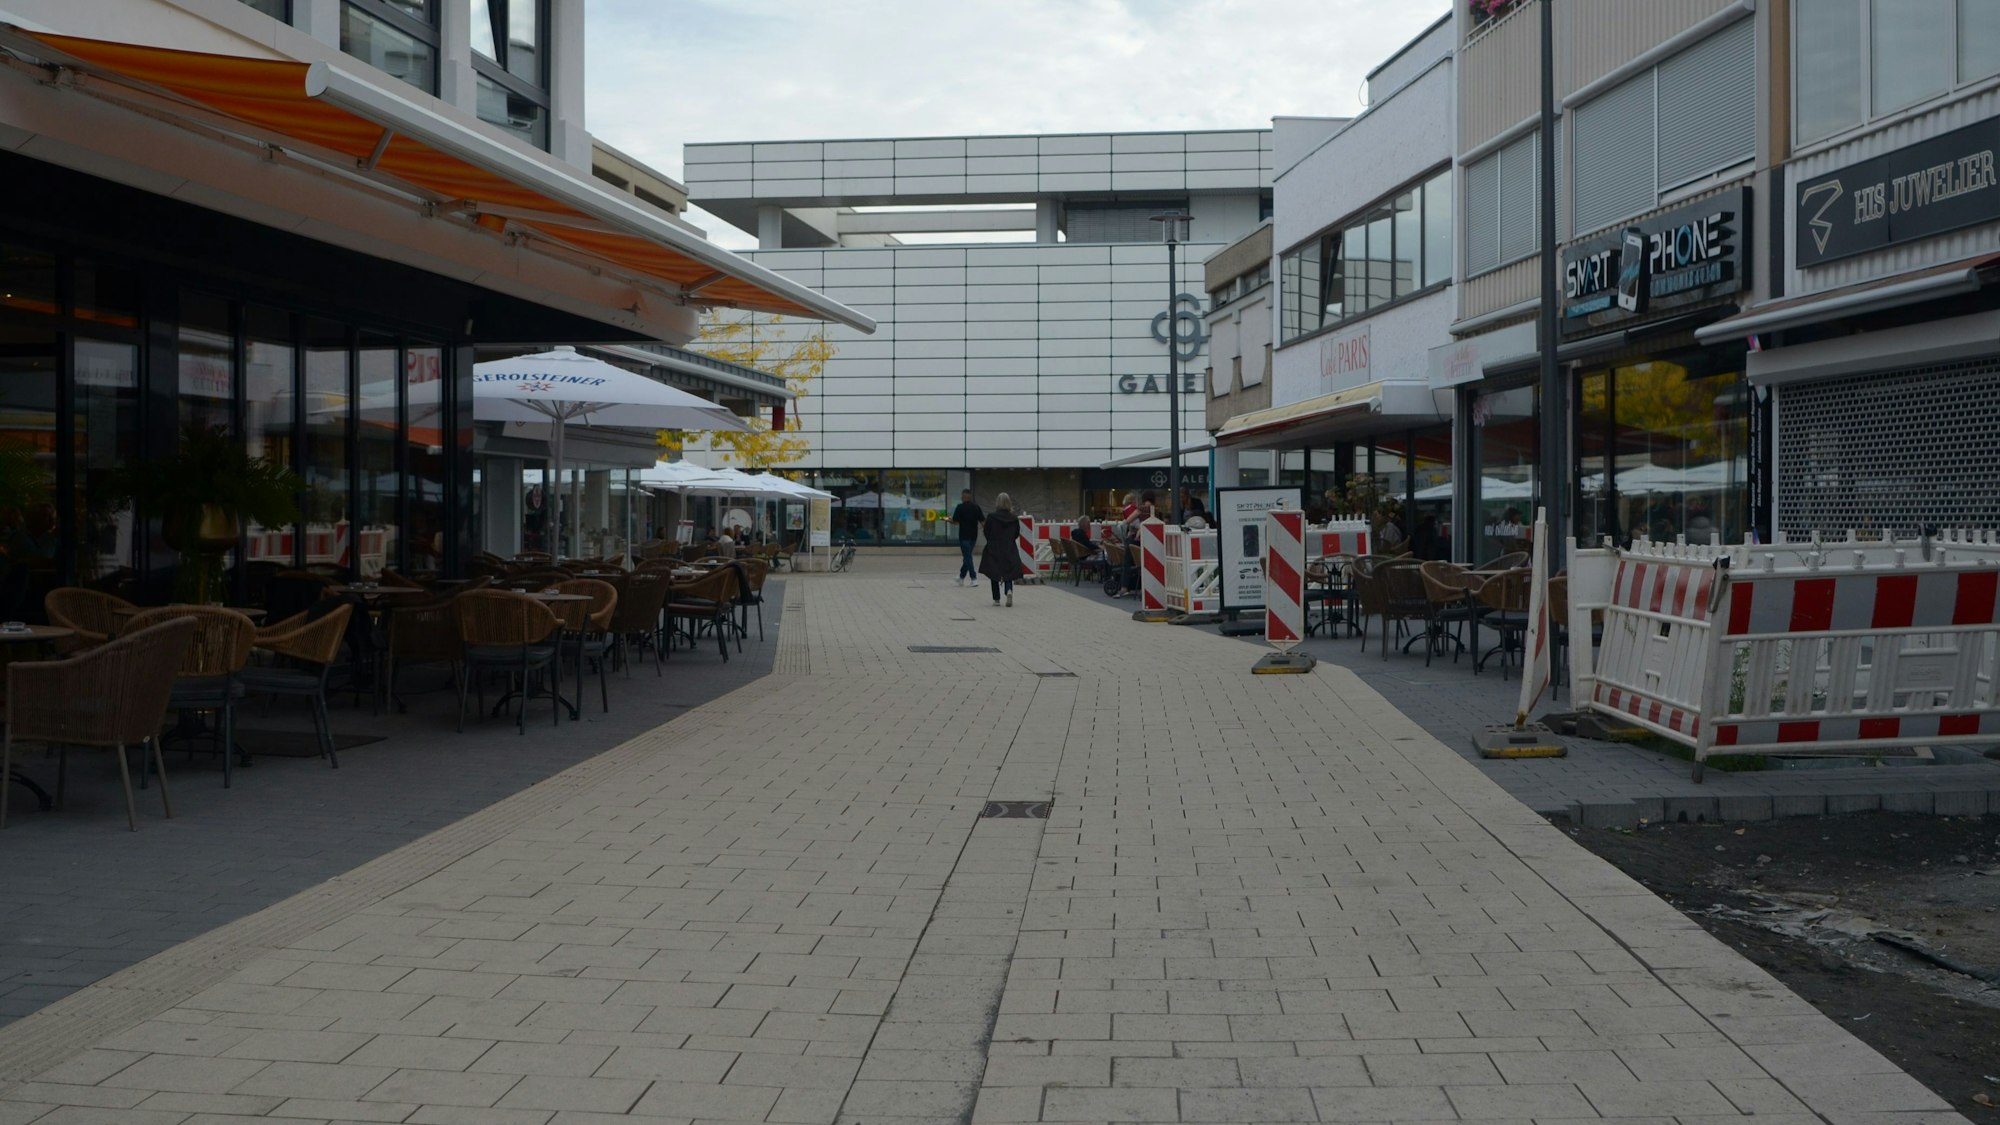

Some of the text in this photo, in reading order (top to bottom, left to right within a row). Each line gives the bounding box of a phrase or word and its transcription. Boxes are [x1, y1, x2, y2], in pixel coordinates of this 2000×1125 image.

[1854, 149, 1997, 225] HIS JUWELIER
[1566, 211, 1722, 299] SMART PHONE
[1339, 334, 1367, 375] PARIS
[473, 372, 606, 387] GEROLSTEINER
[1118, 373, 1205, 394] GALE
[1181, 474, 1210, 484] ALE
